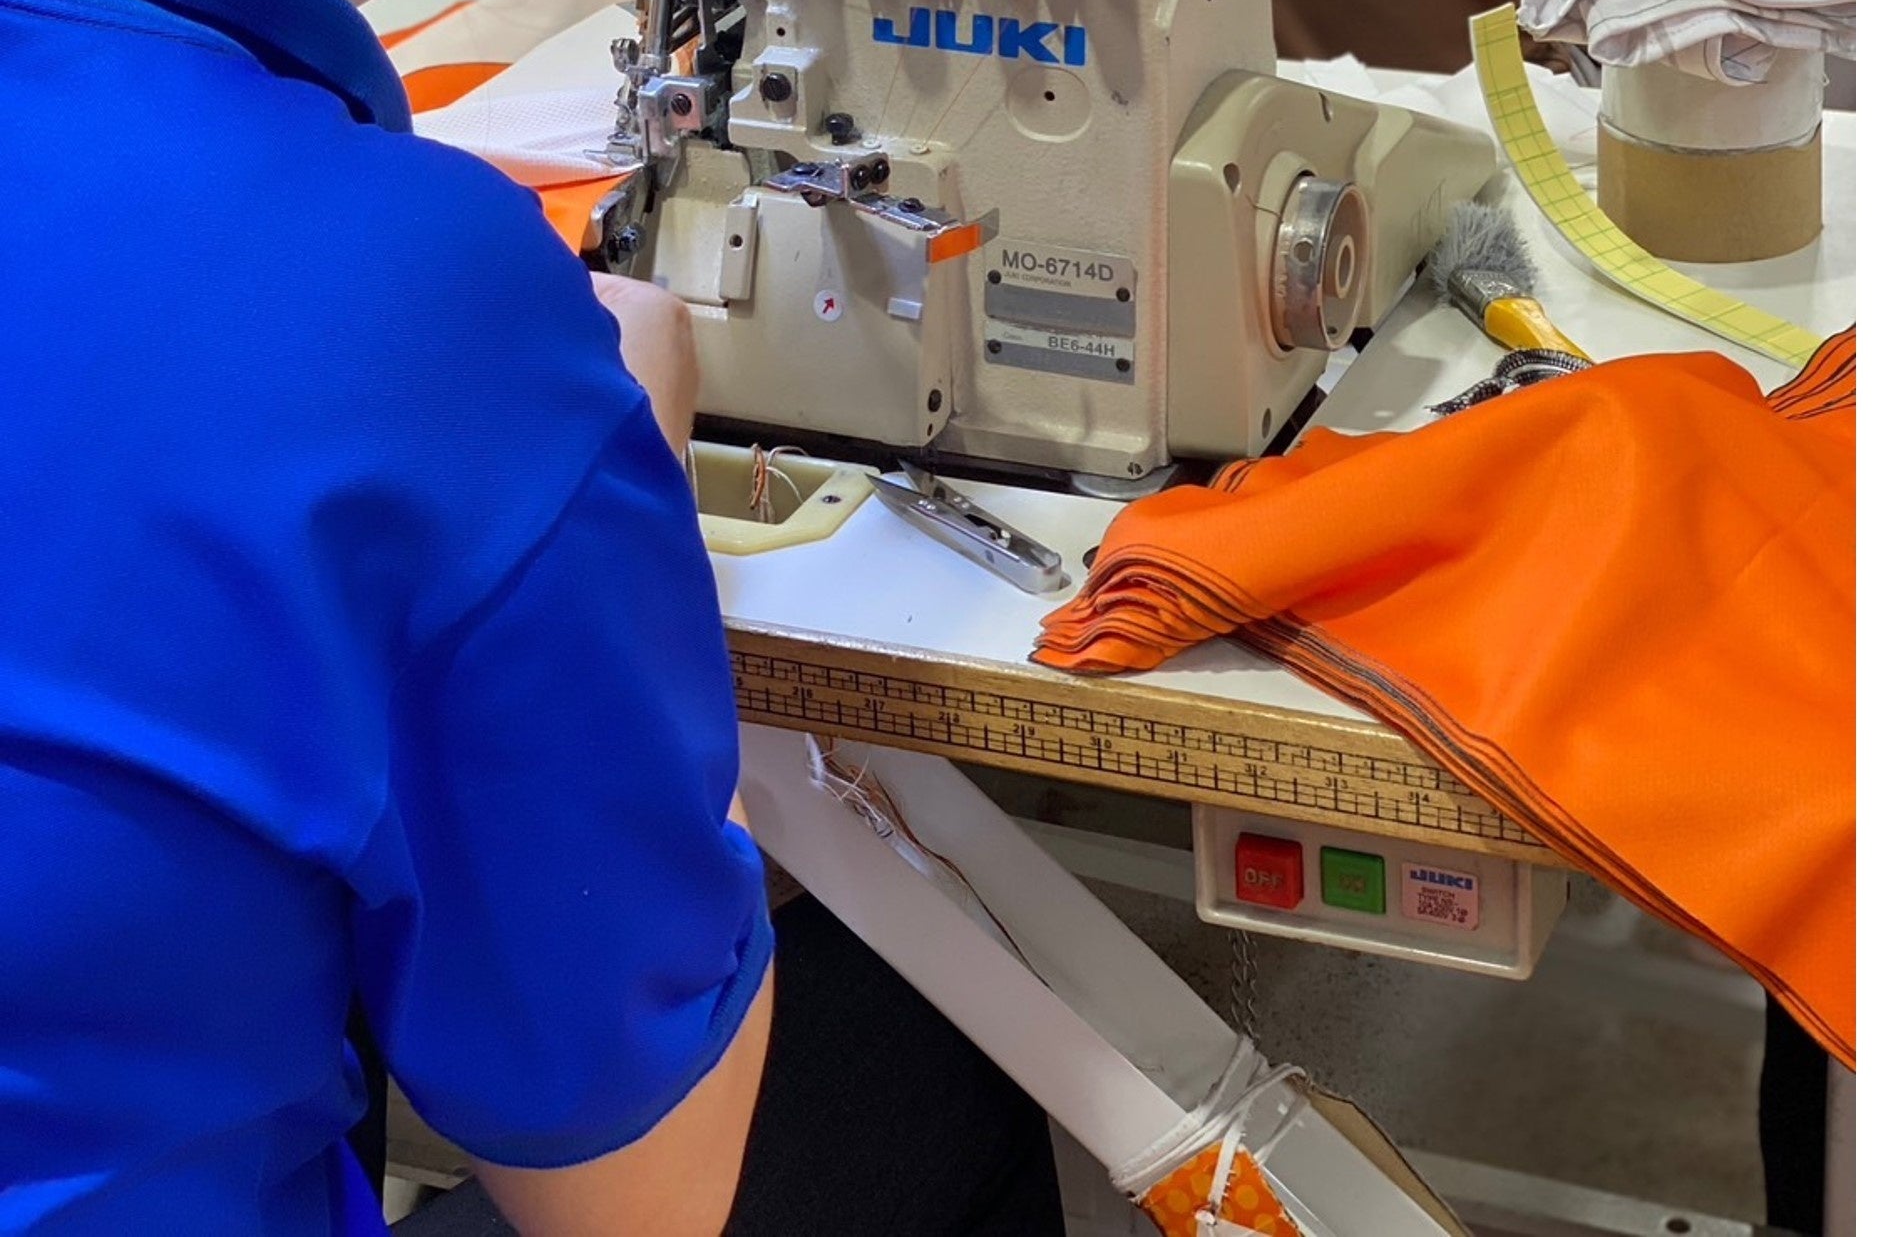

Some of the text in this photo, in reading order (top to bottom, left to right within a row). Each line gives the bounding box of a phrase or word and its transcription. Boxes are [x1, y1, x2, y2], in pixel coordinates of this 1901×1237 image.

[873, 7, 1085, 66] JUKI
[1002, 249, 1113, 281] MO-6714D
[1048, 336, 1115, 357] BE6-44H
[1244, 867, 1284, 890] OFF
[1410, 869, 1473, 891] JUKI
